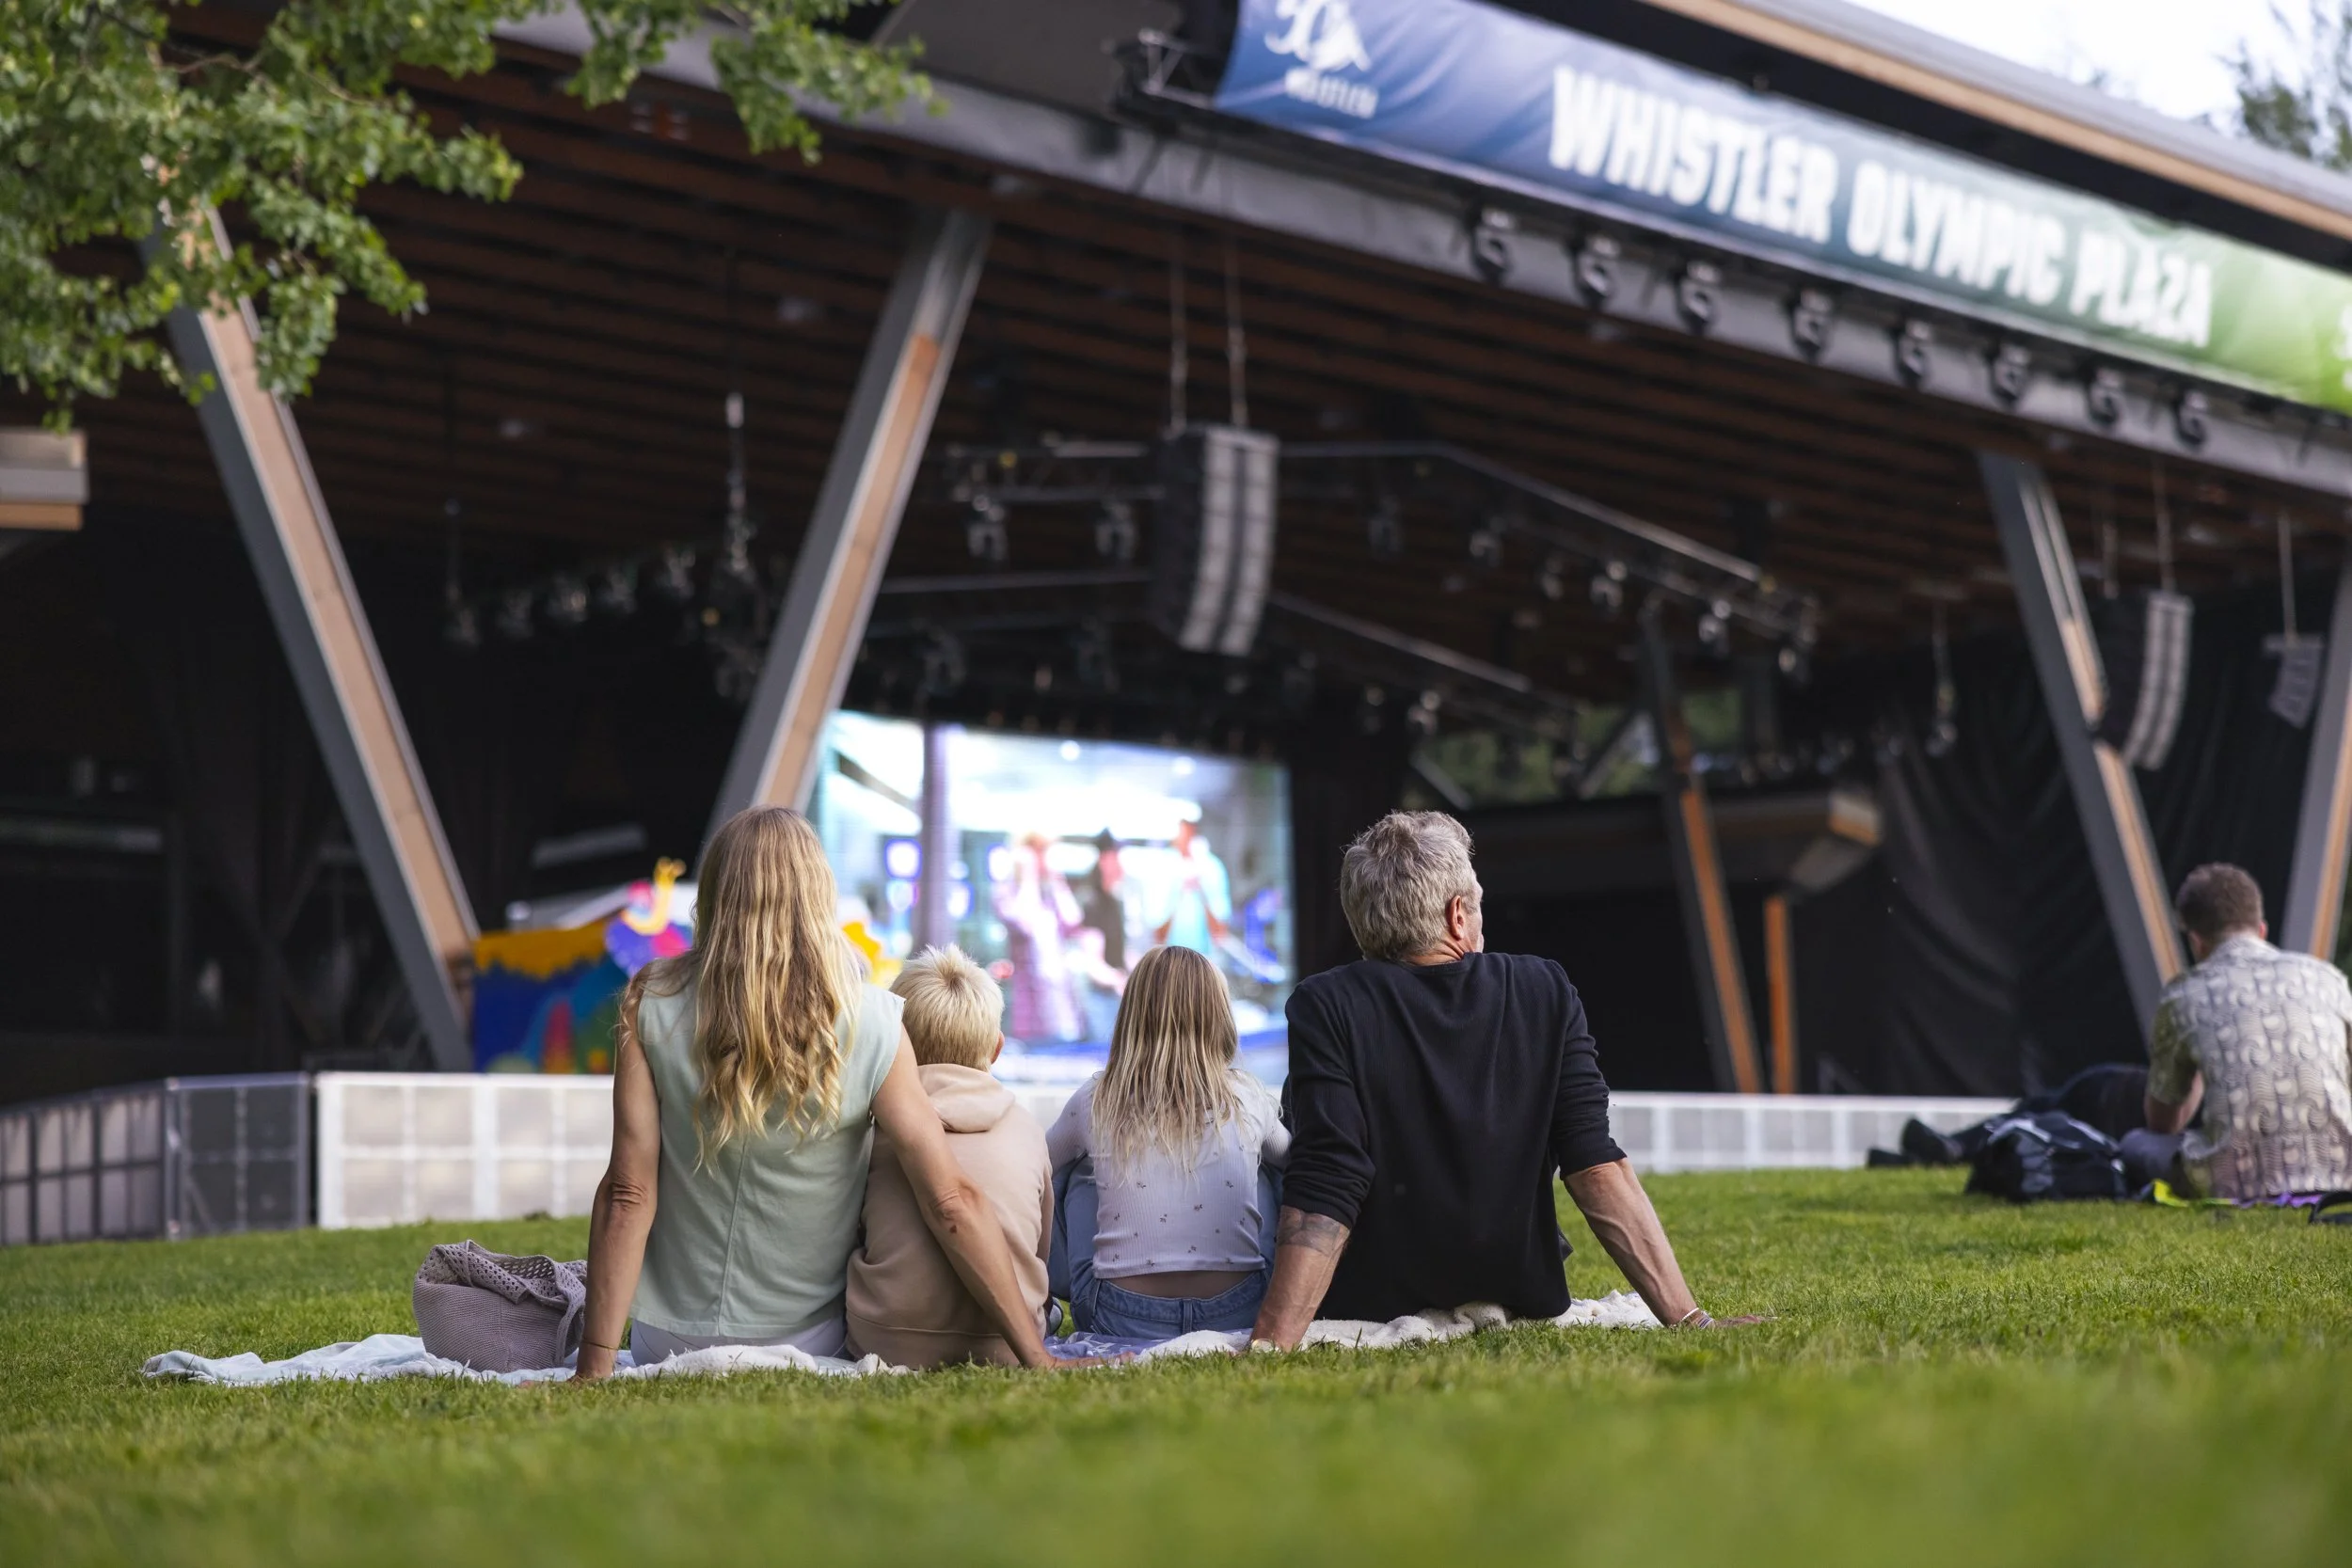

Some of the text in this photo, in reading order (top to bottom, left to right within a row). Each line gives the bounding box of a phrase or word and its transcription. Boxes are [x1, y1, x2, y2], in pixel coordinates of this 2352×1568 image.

[1549, 64, 2213, 349] WHISTLER OLYMPIC PLAZA
